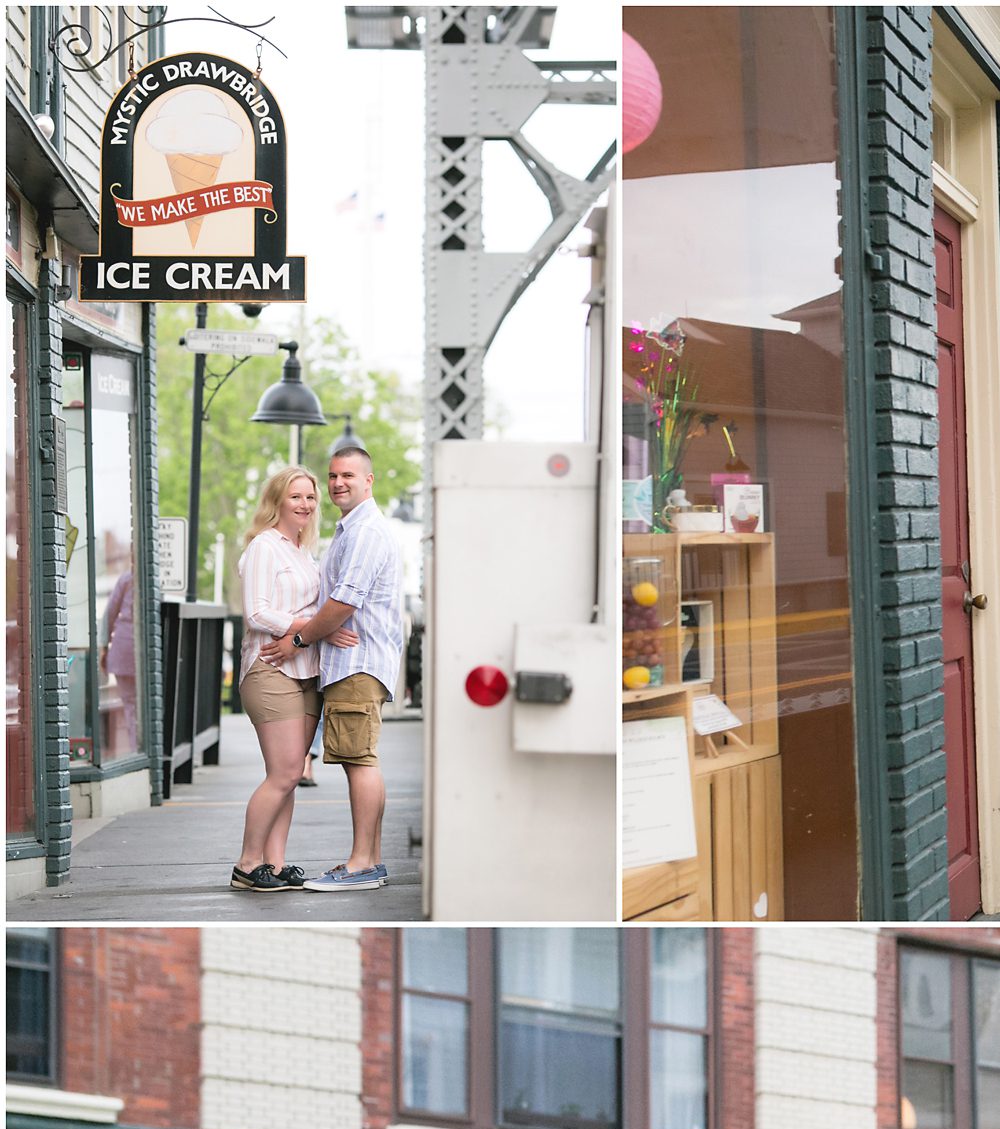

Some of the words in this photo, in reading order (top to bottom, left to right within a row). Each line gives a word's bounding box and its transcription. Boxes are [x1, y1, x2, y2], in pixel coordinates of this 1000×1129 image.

[110, 73, 160, 145] MYSTIC
[162, 61, 278, 145] DRAWBRIDGE
[151, 197, 197, 221] MAKE
[200, 188, 230, 208] THE
[97, 262, 150, 290] ICE
[165, 262, 290, 290] CREAM
